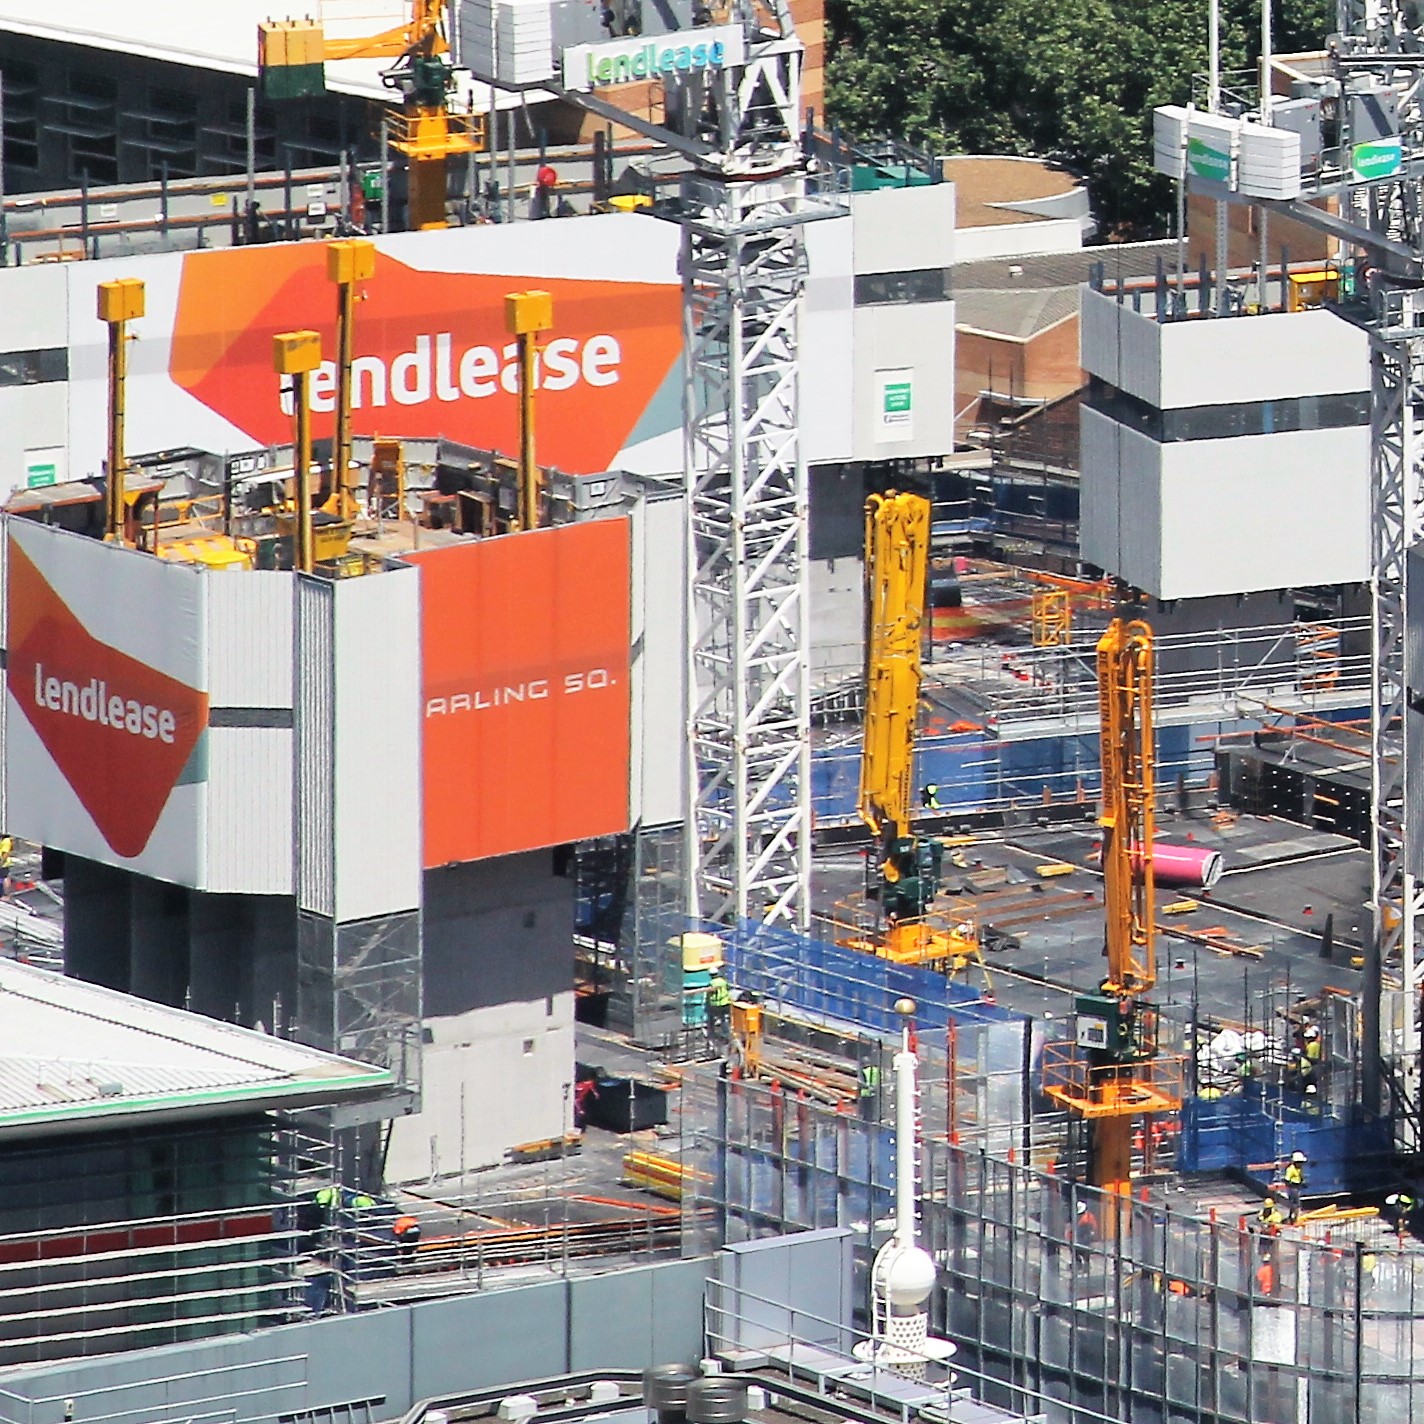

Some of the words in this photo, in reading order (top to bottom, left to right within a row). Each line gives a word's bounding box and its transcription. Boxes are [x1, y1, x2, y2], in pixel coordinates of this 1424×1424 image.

[587, 39, 725, 82] lendlease
[35, 663, 176, 743] lendlease
[426, 680, 549, 718] ARLING
